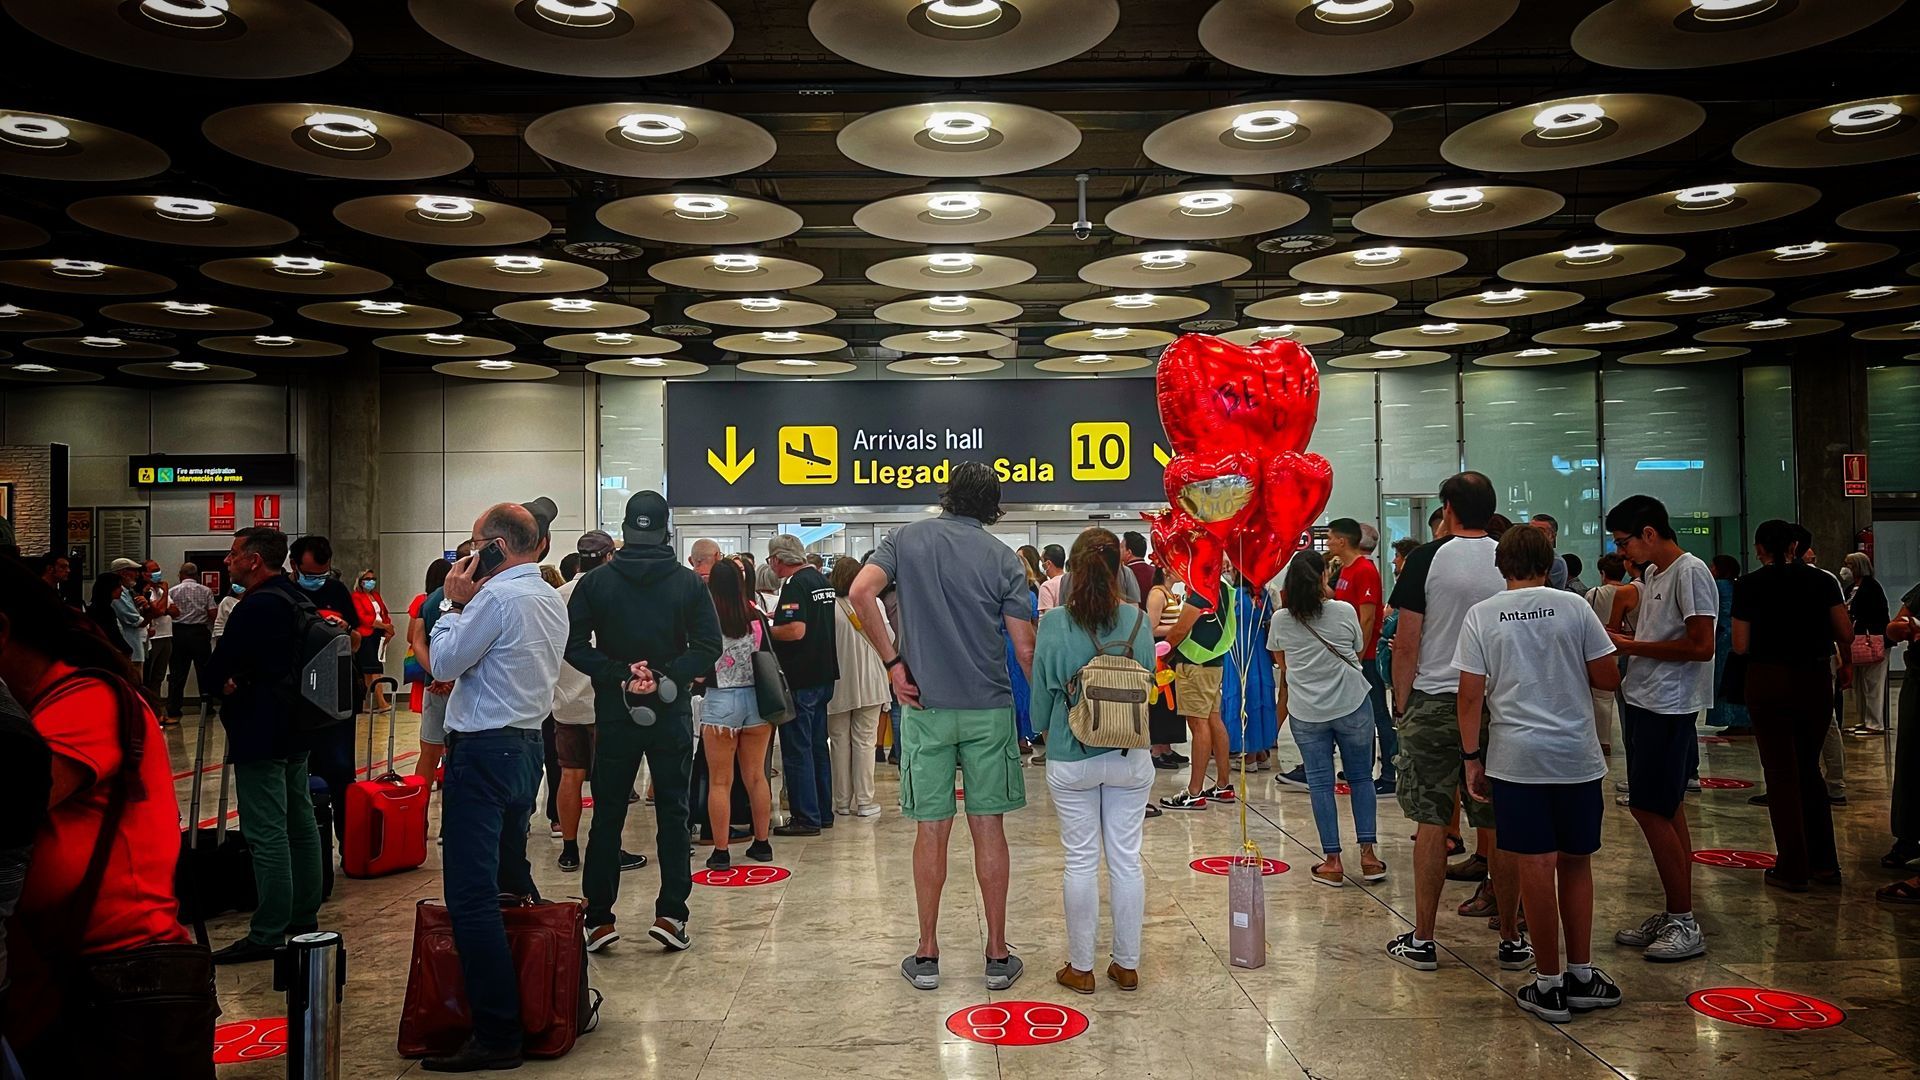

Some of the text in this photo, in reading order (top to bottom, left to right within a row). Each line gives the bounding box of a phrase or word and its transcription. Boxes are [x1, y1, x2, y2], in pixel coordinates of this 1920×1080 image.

[853, 428, 983, 450] Arrivals hall
[1077, 433, 1125, 469] 10
[853, 457, 1055, 489] Llegad Sala
[1499, 607, 1555, 622] Antamira
